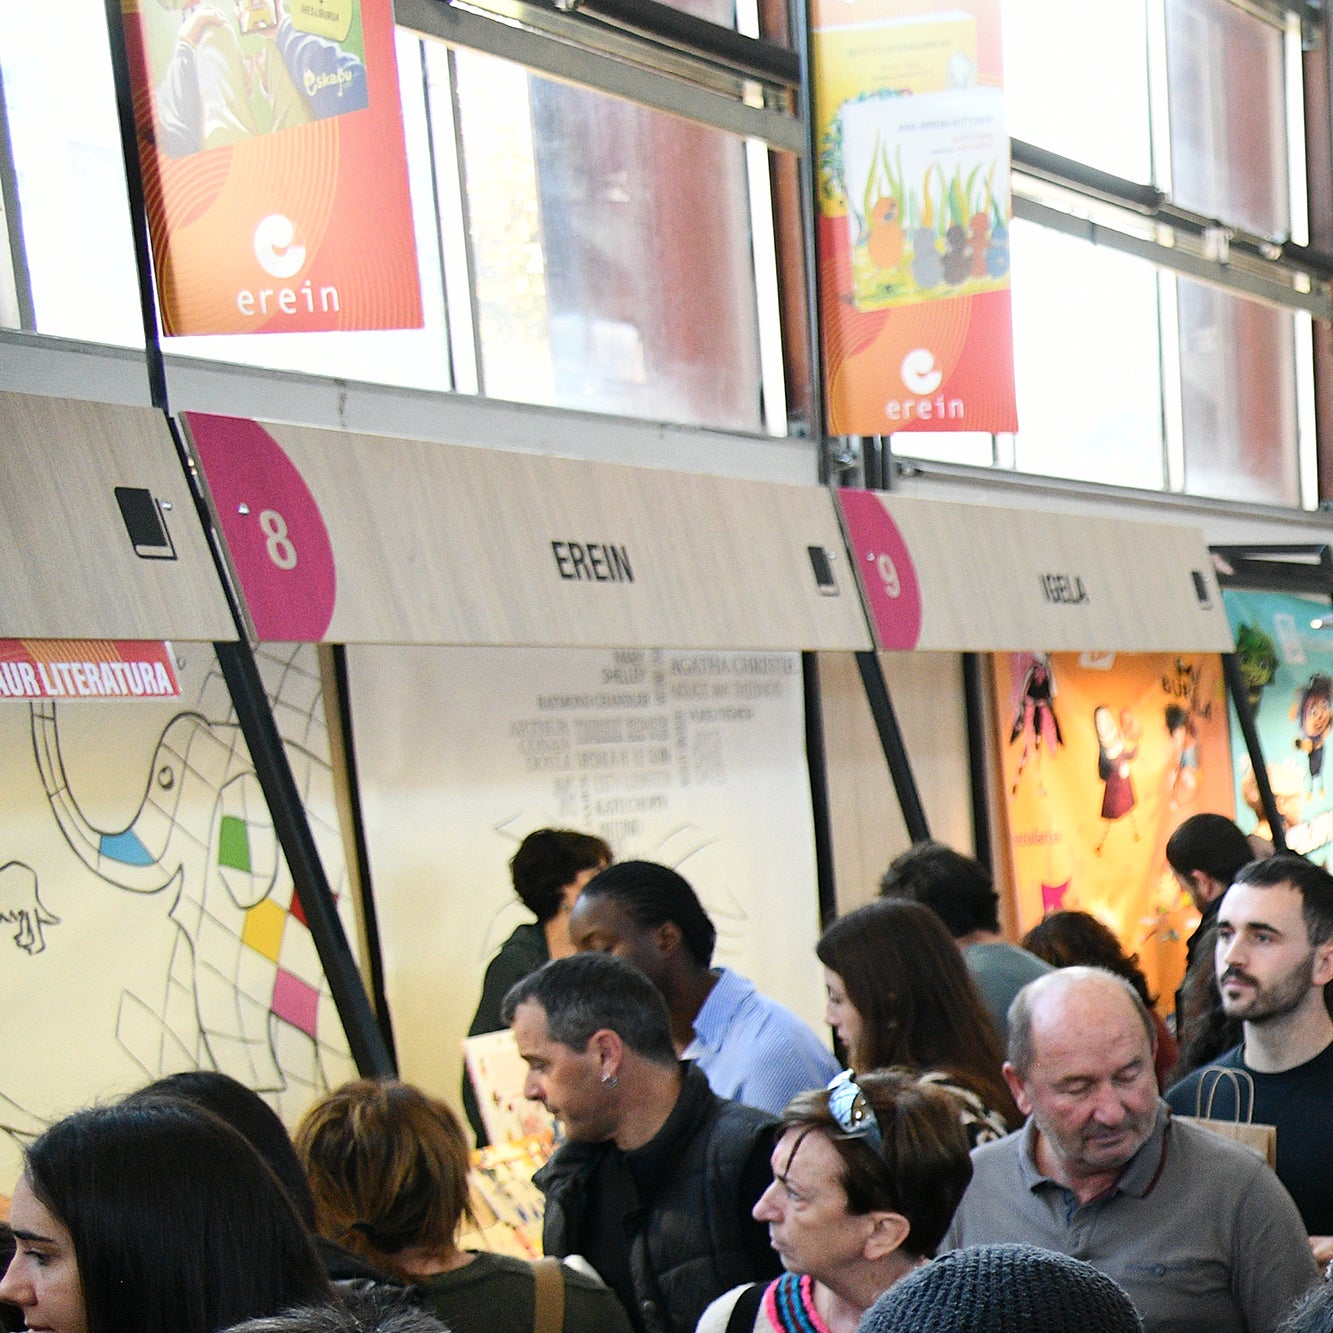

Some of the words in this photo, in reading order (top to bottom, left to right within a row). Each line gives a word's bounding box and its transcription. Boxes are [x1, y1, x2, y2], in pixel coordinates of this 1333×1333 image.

[237, 278, 340, 317] erein
[884, 394, 966, 421] erein
[259, 509, 298, 571] 8
[551, 540, 635, 583] EREIN
[877, 552, 901, 600] 9
[1039, 573, 1090, 605] IGELA
[38, 661, 175, 697] LITERATURA
